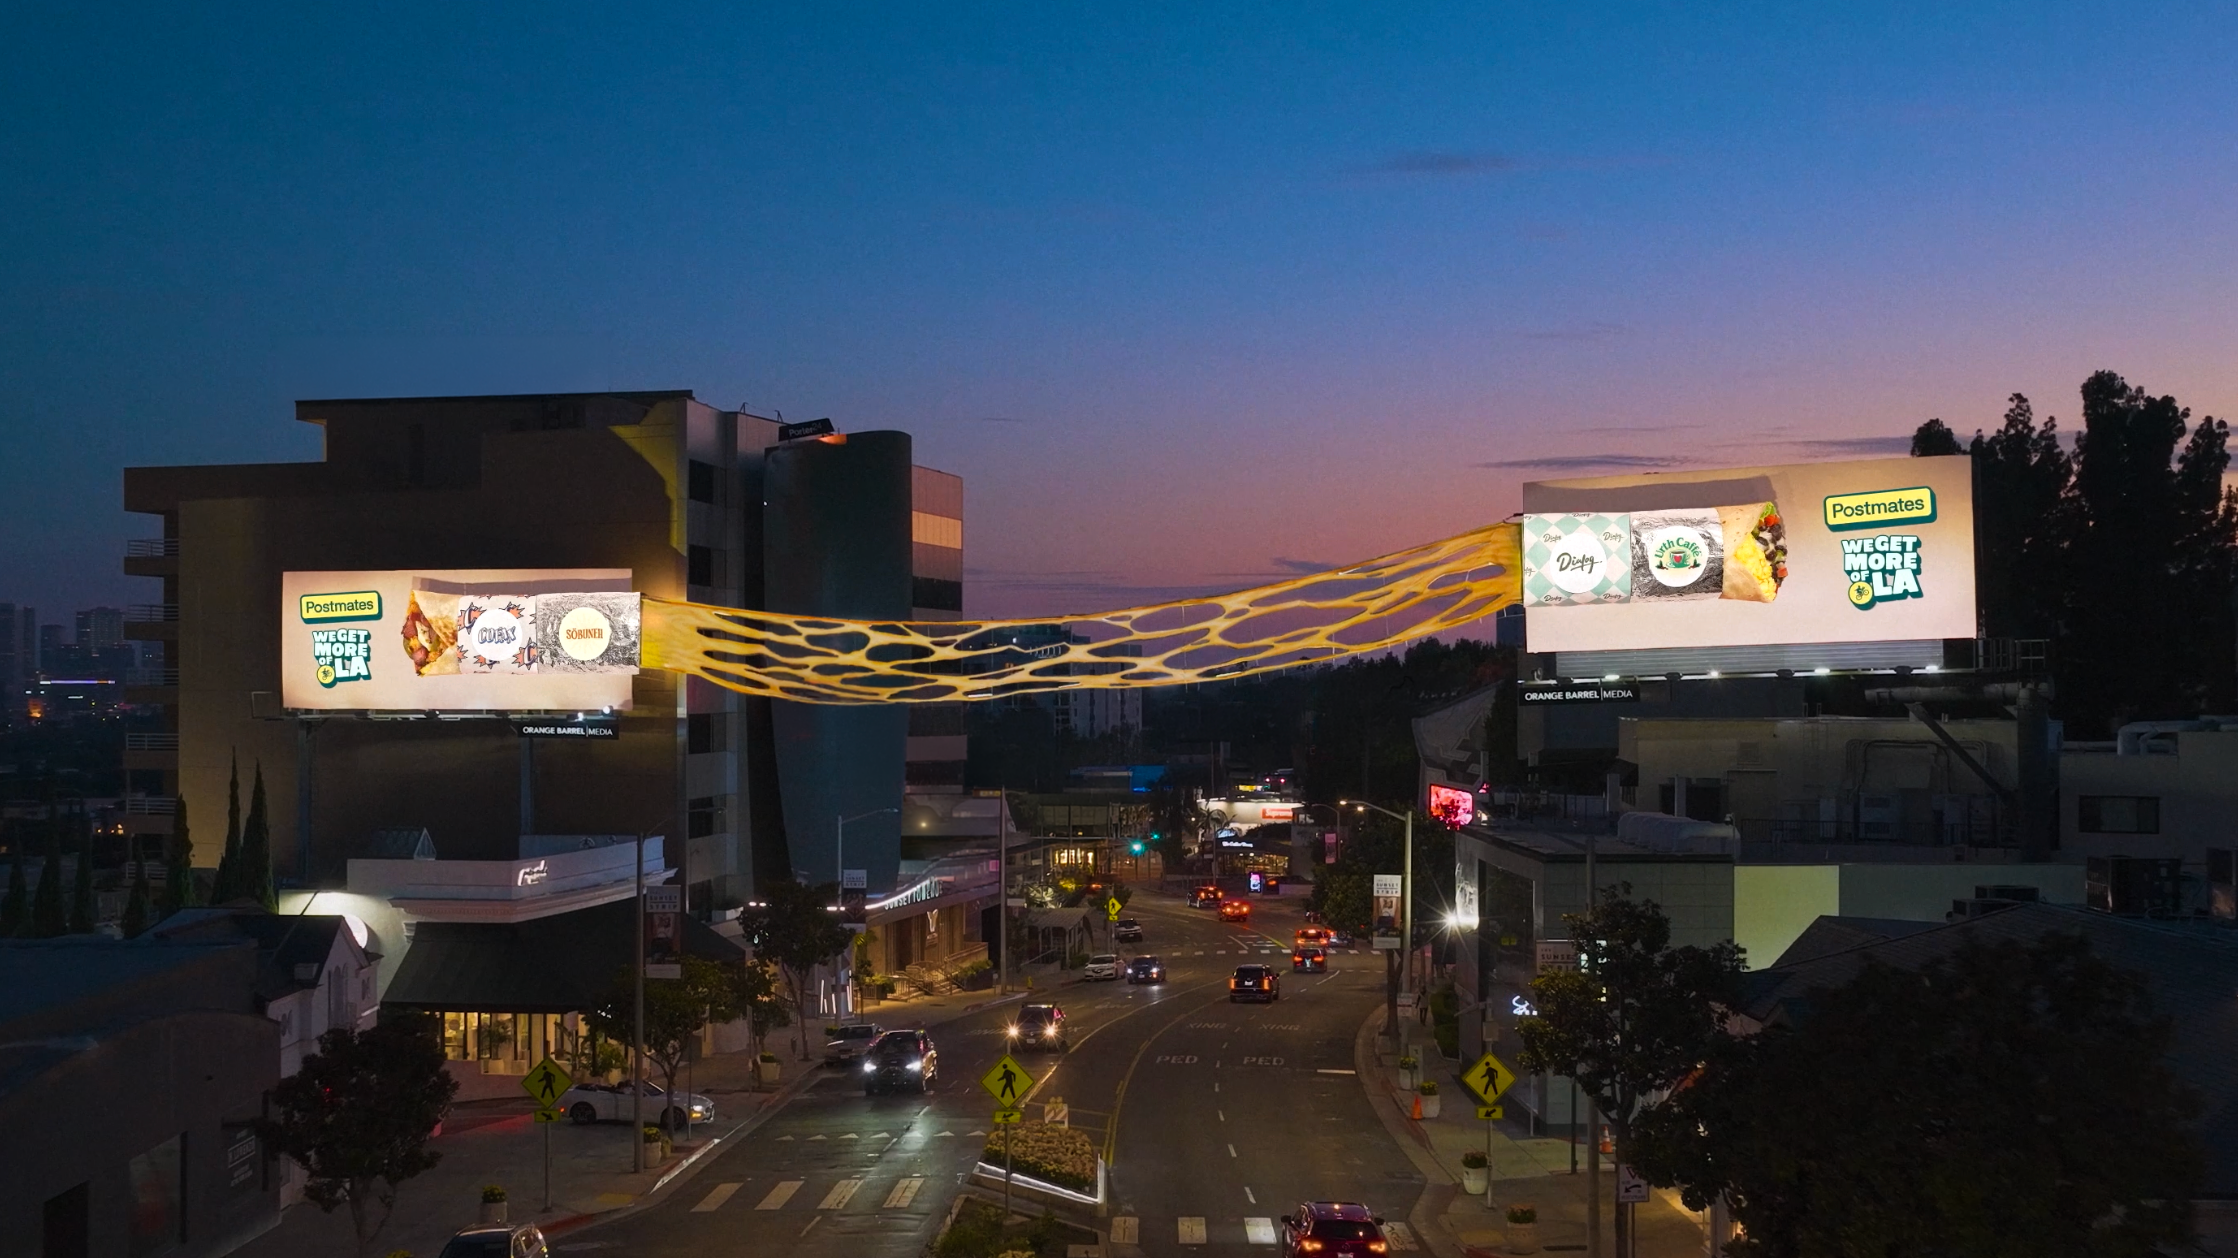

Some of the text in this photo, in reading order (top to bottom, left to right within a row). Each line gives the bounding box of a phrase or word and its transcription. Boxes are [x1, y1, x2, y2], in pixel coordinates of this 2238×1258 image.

[1832, 498, 1925, 518] Postmates
[1654, 539, 1675, 558] Urth
[1841, 535, 1918, 553] WE GET
[1557, 552, 1602, 574] Dialog
[1844, 552, 1918, 570] MORE
[1850, 568, 1919, 596] OF LA
[305, 599, 374, 613] Postmates
[313, 629, 368, 642] WE GET
[314, 642, 368, 656] MORE
[318, 655, 368, 677] OF LA
[1524, 689, 1633, 701] ORANGE BARREL MEDIA
[522, 726, 613, 736] ORANGE BARREL MEDIA
[1155, 1055, 1285, 1065] PED PED
